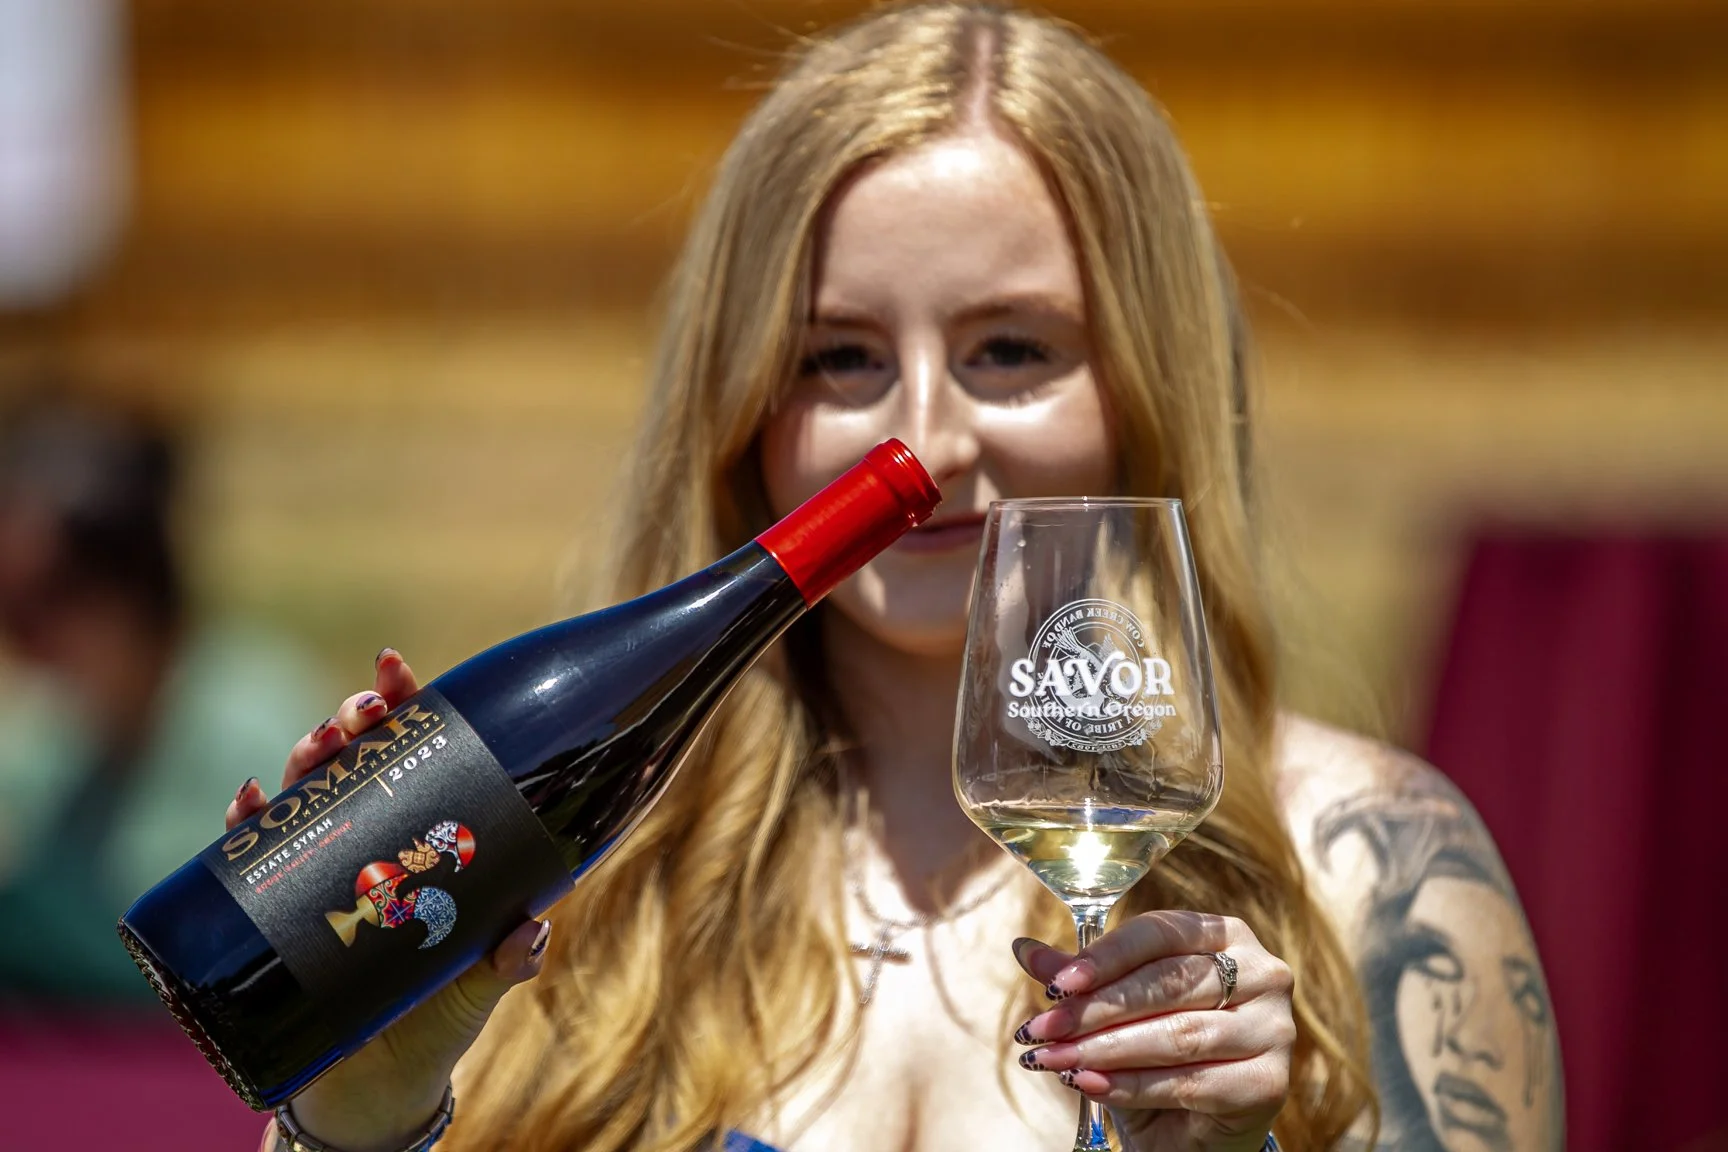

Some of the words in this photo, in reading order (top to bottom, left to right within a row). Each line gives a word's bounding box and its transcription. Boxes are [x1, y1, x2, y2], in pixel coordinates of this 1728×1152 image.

[1009, 651, 1175, 698] SAVOR
[1007, 701, 1102, 719] Southern
[1103, 701, 1177, 720] Oregon
[222, 704, 433, 861] SOMAR
[281, 787, 339, 833] FAMILY
[350, 714, 440, 781] VINEYARDS
[388, 735, 447, 782] 2023
[246, 849, 291, 885] ESTATE
[292, 818, 333, 850] SYRAH
